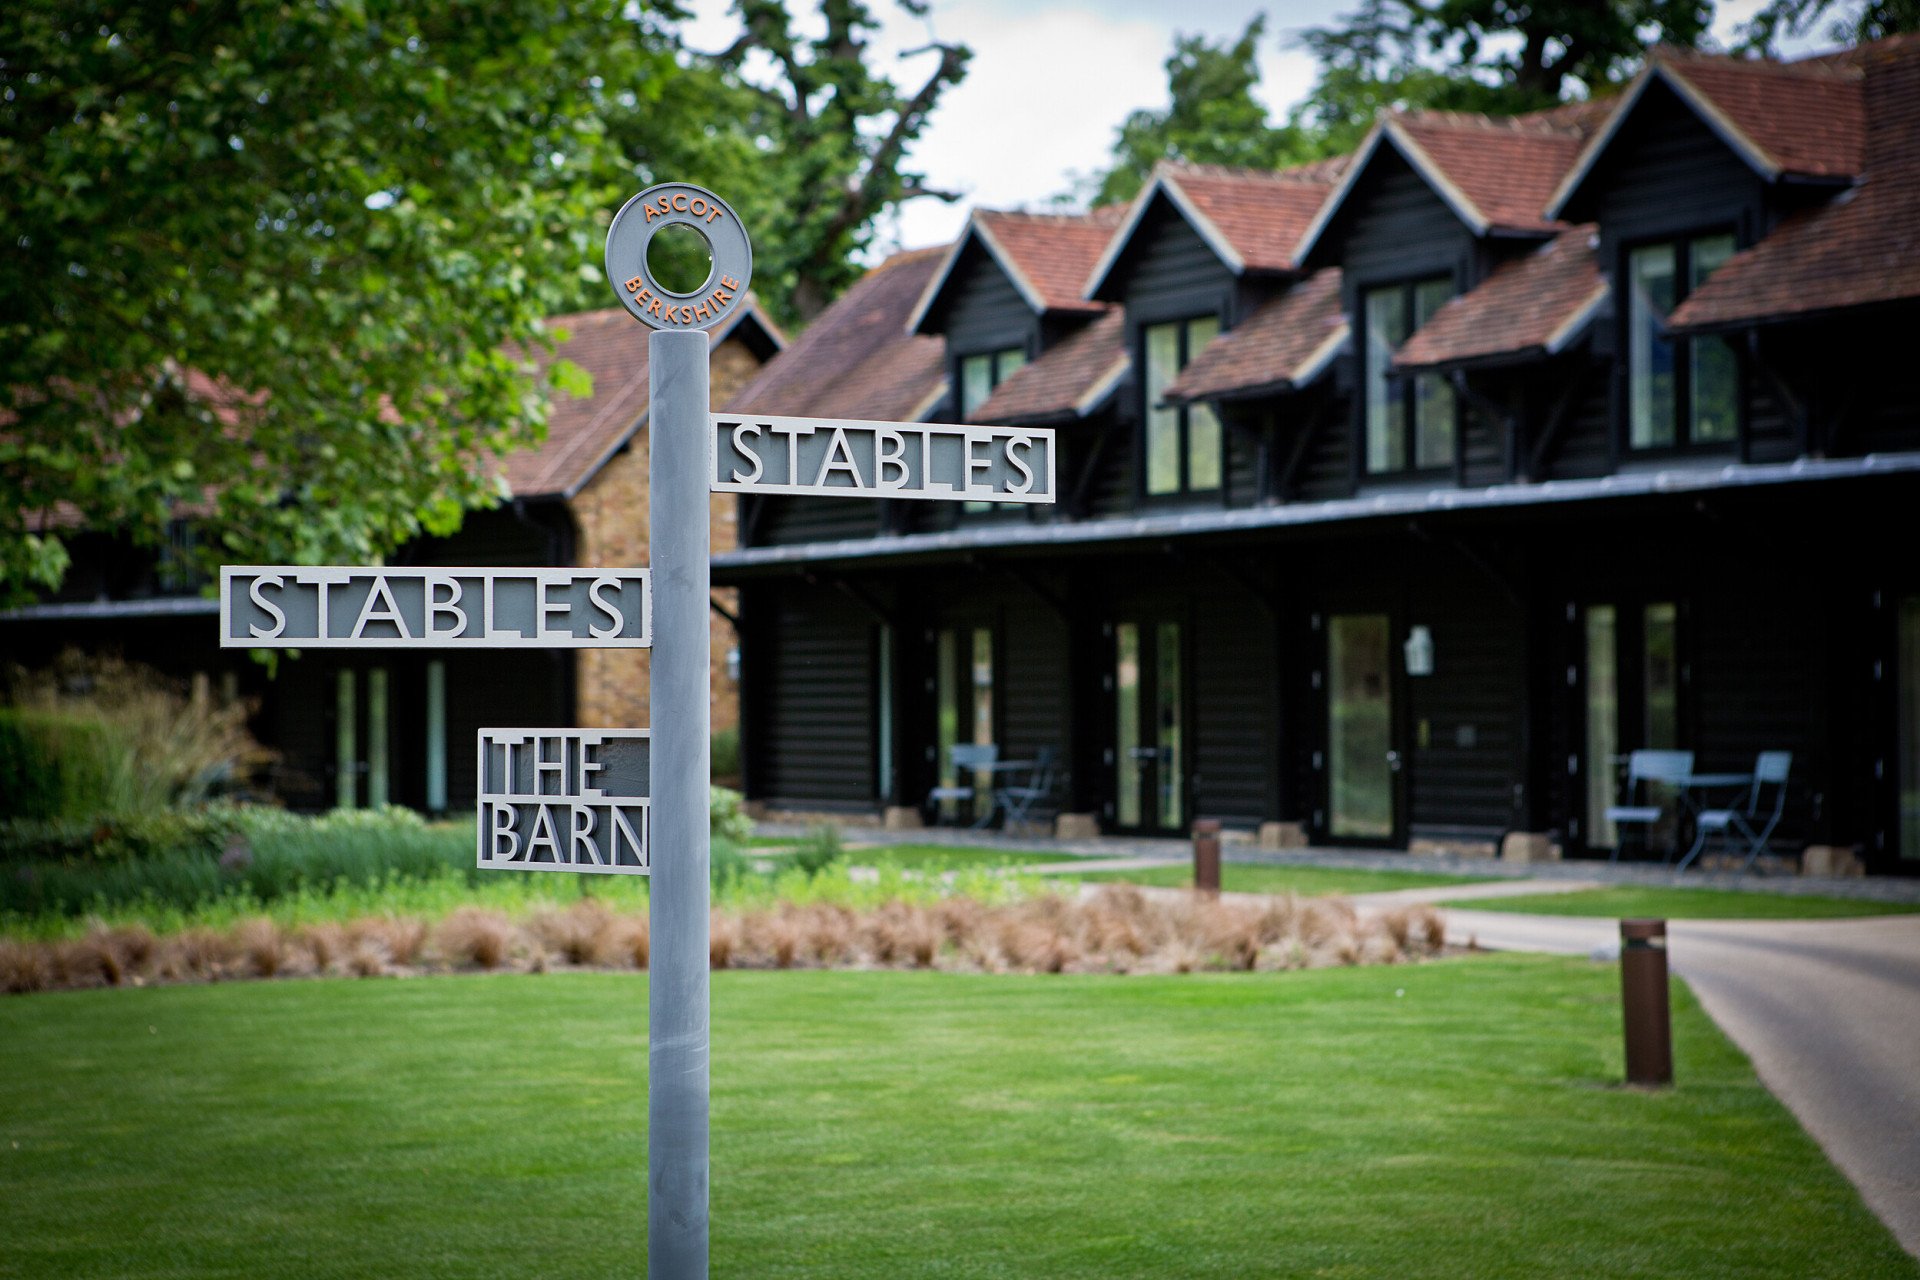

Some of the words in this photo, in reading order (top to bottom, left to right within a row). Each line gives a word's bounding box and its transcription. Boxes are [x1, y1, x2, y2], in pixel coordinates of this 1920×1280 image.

[644, 194, 723, 223] ASCOT
[625, 274, 739, 324] BERKSHIRE
[731, 423, 1034, 493] STABLES
[249, 575, 624, 639] STABLES
[492, 736, 604, 797] THE
[491, 802, 648, 867] BARN
